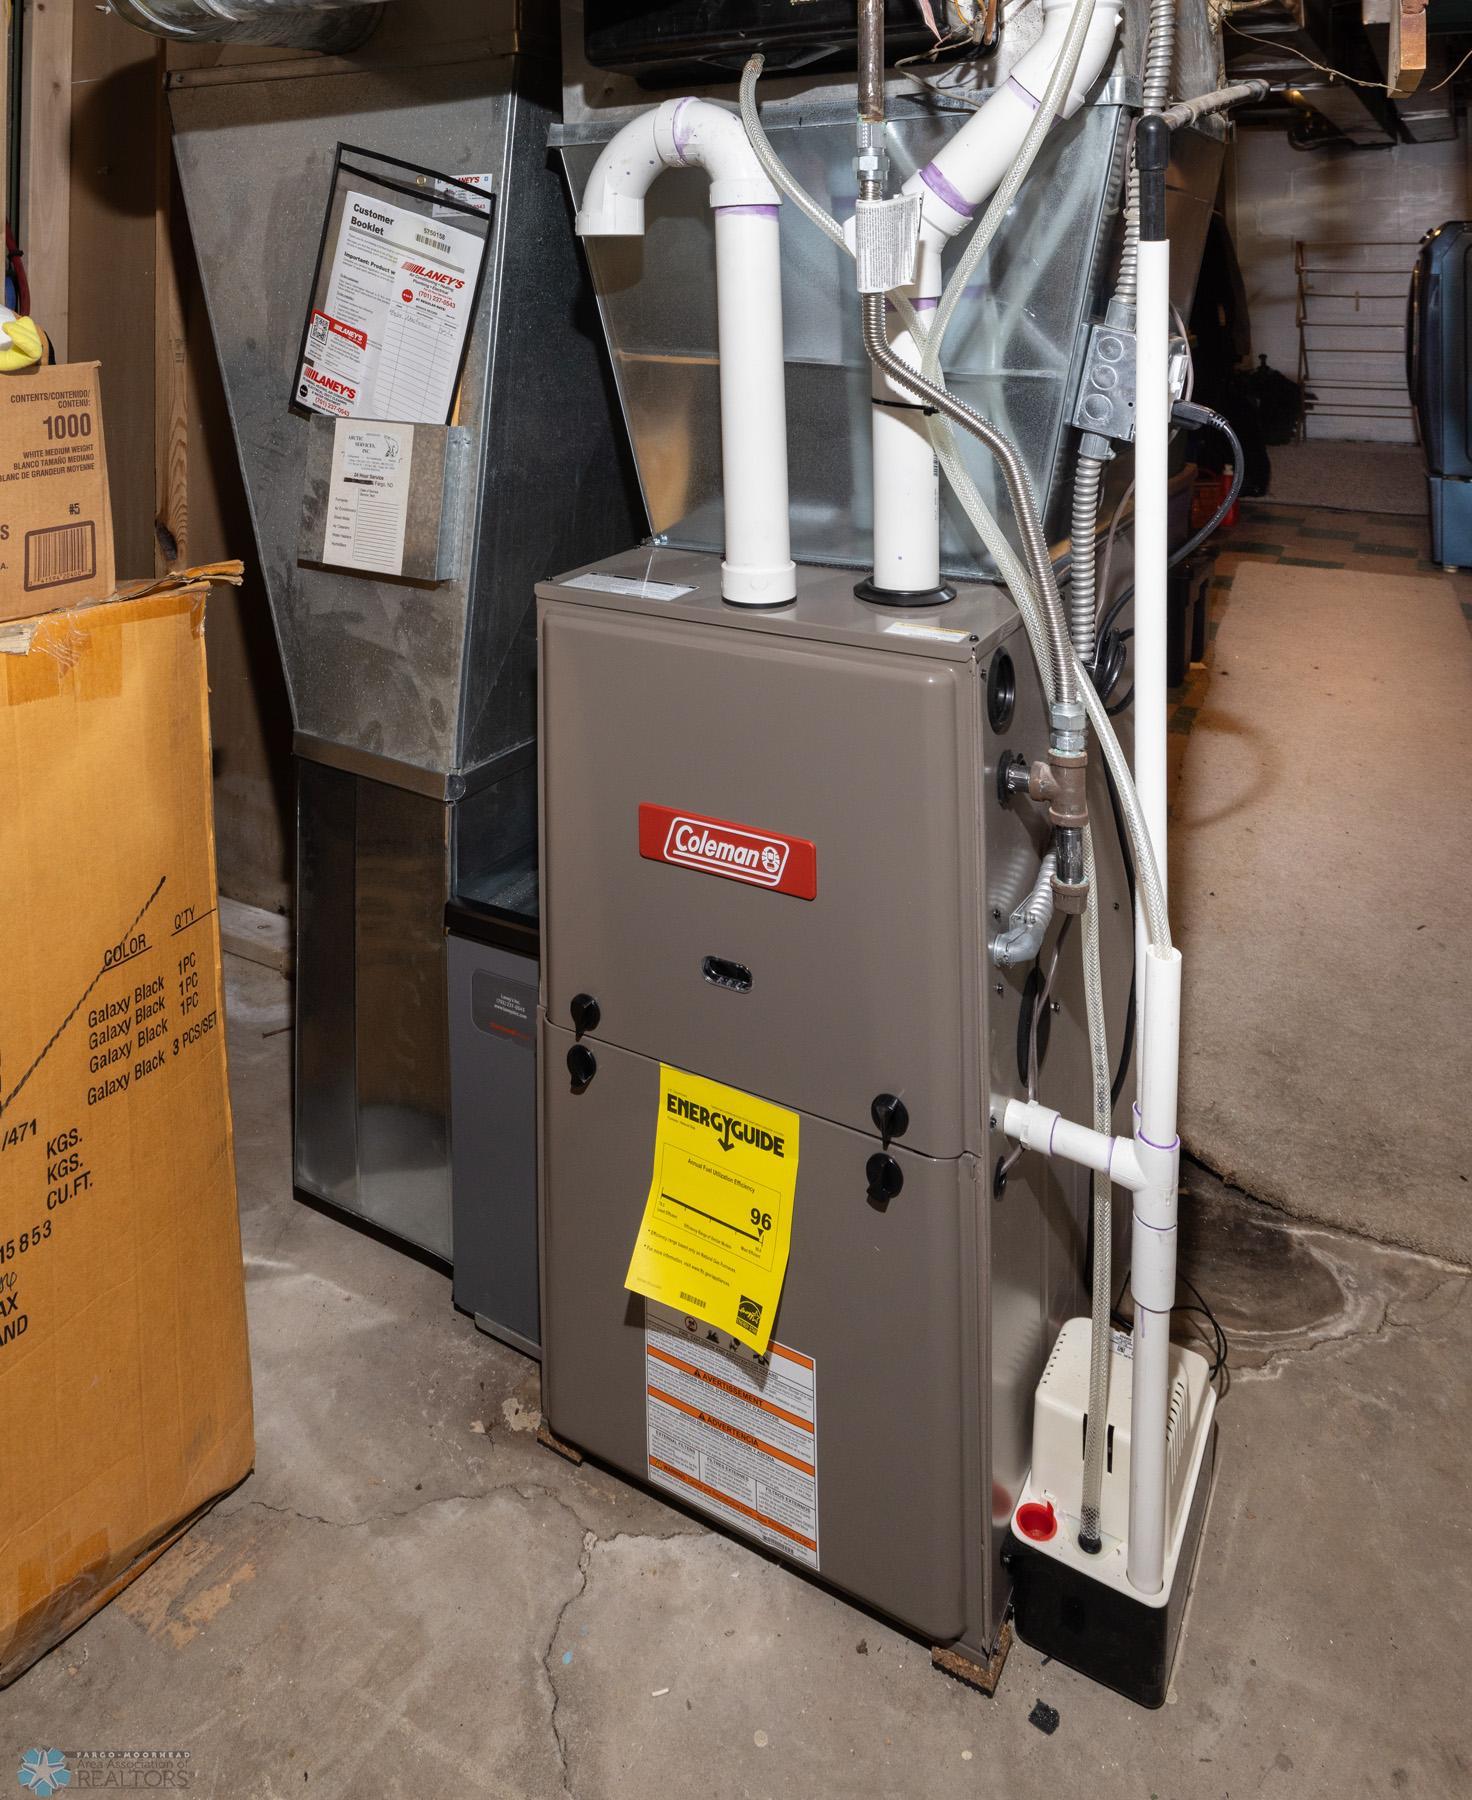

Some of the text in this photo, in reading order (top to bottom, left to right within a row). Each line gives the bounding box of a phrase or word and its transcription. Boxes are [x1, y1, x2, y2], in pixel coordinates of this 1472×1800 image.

[351, 216, 385, 236] Booklet
[353, 203, 395, 226] Customer
[344, 251, 370, 265] Important:
[370, 261, 390, 273] Product
[417, 265, 466, 289] LANEY'S
[418, 290, 432, 300] (701)
[339, 326, 364, 341] LANEY'S
[314, 371, 356, 399] LANEY'S
[58, 399, 91, 409] CONTENU:
[42, 412, 92, 441] 1000
[13, 453, 95, 471] BLANCO TAMAÑO MEDIANO
[23, 444, 94, 459] WHITE MEDIUM WEIGHT
[21, 471, 30, 480] DE
[31, 466, 66, 478] GRANDEUR
[66, 463, 95, 473] MOYENNE
[69, 503, 81, 515] #5
[675, 825, 760, 867] Coleman
[174, 905, 195, 930] Q'TY
[104, 933, 147, 967] COLOR
[88, 952, 196, 1028] Galaxy Black 1PC
[89, 972, 198, 1050] Galaxy Black 1PC
[89, 992, 198, 1073] Galaxy Black 1PC
[87, 1010, 217, 1106] Galaxy Black 3 PCS/SET
[667, 1093, 785, 1158] ENERGYGUIDE
[47, 1128, 82, 1159] KGS.
[47, 1153, 83, 1185] KGS.
[688, 1159, 755, 1194] Annual Fuel Utilization Efficiency
[47, 1170, 93, 1211] CU.FT.
[750, 1207, 772, 1231] 96
[703, 1373, 764, 1407] AVERTISSEMENT
[656, 1430, 677, 1445] EXTERNAL
[678, 1441, 695, 1454] FILTERS
[708, 1417, 759, 1447] ADVERTENCIA
[725, 1467, 749, 1481] EXTERNES
[765, 1487, 811, 1513] FILTROS EXTERNOS
